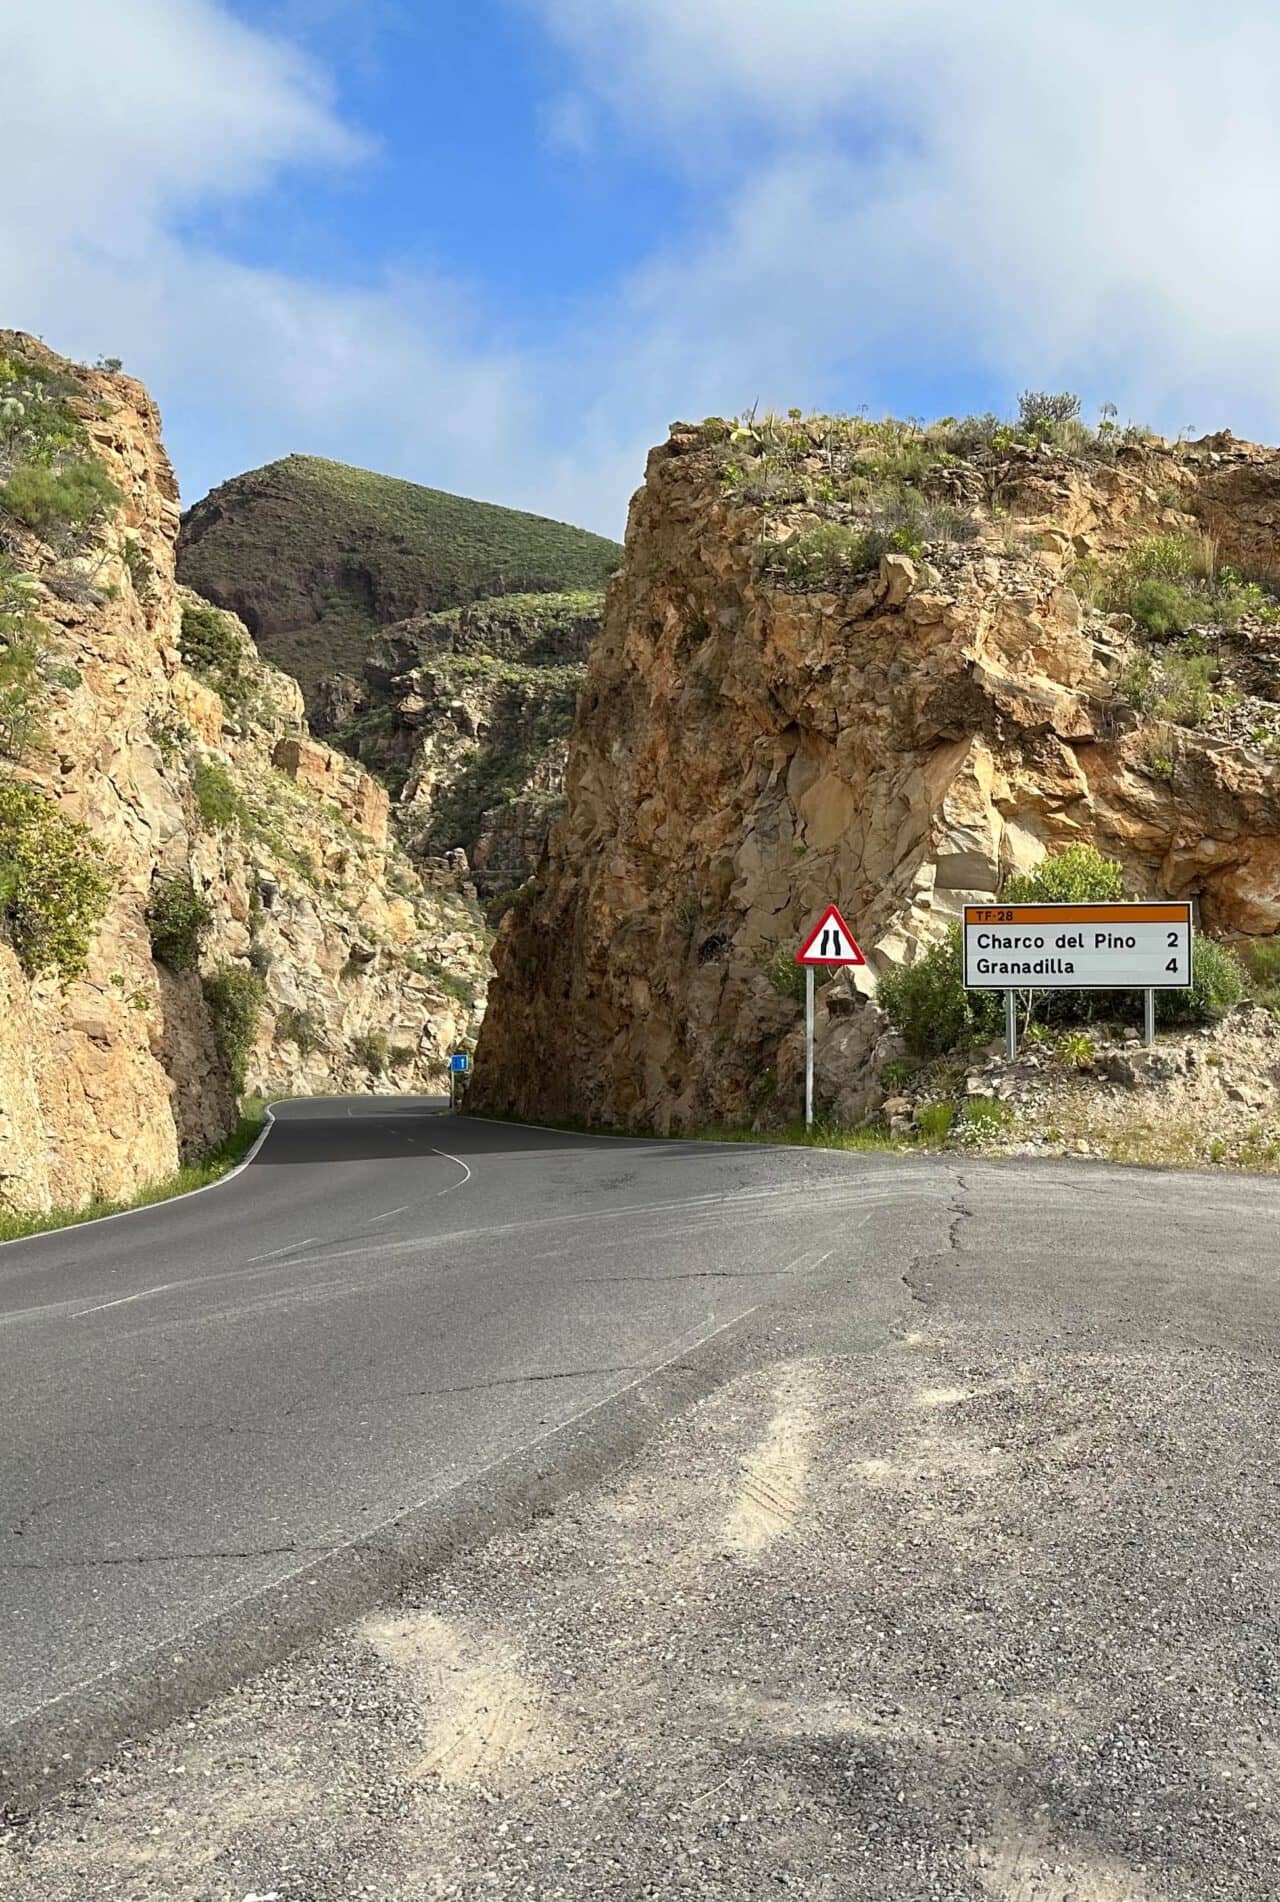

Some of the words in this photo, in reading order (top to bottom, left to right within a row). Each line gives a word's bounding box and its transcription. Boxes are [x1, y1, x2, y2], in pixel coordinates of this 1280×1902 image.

[977, 933, 1044, 949] Charco
[1055, 933, 1084, 948] del
[1095, 933, 1136, 948] Pino
[1167, 932, 1178, 948] 2
[977, 958, 1074, 974] Granadilla
[1165, 958, 1178, 973] 4
